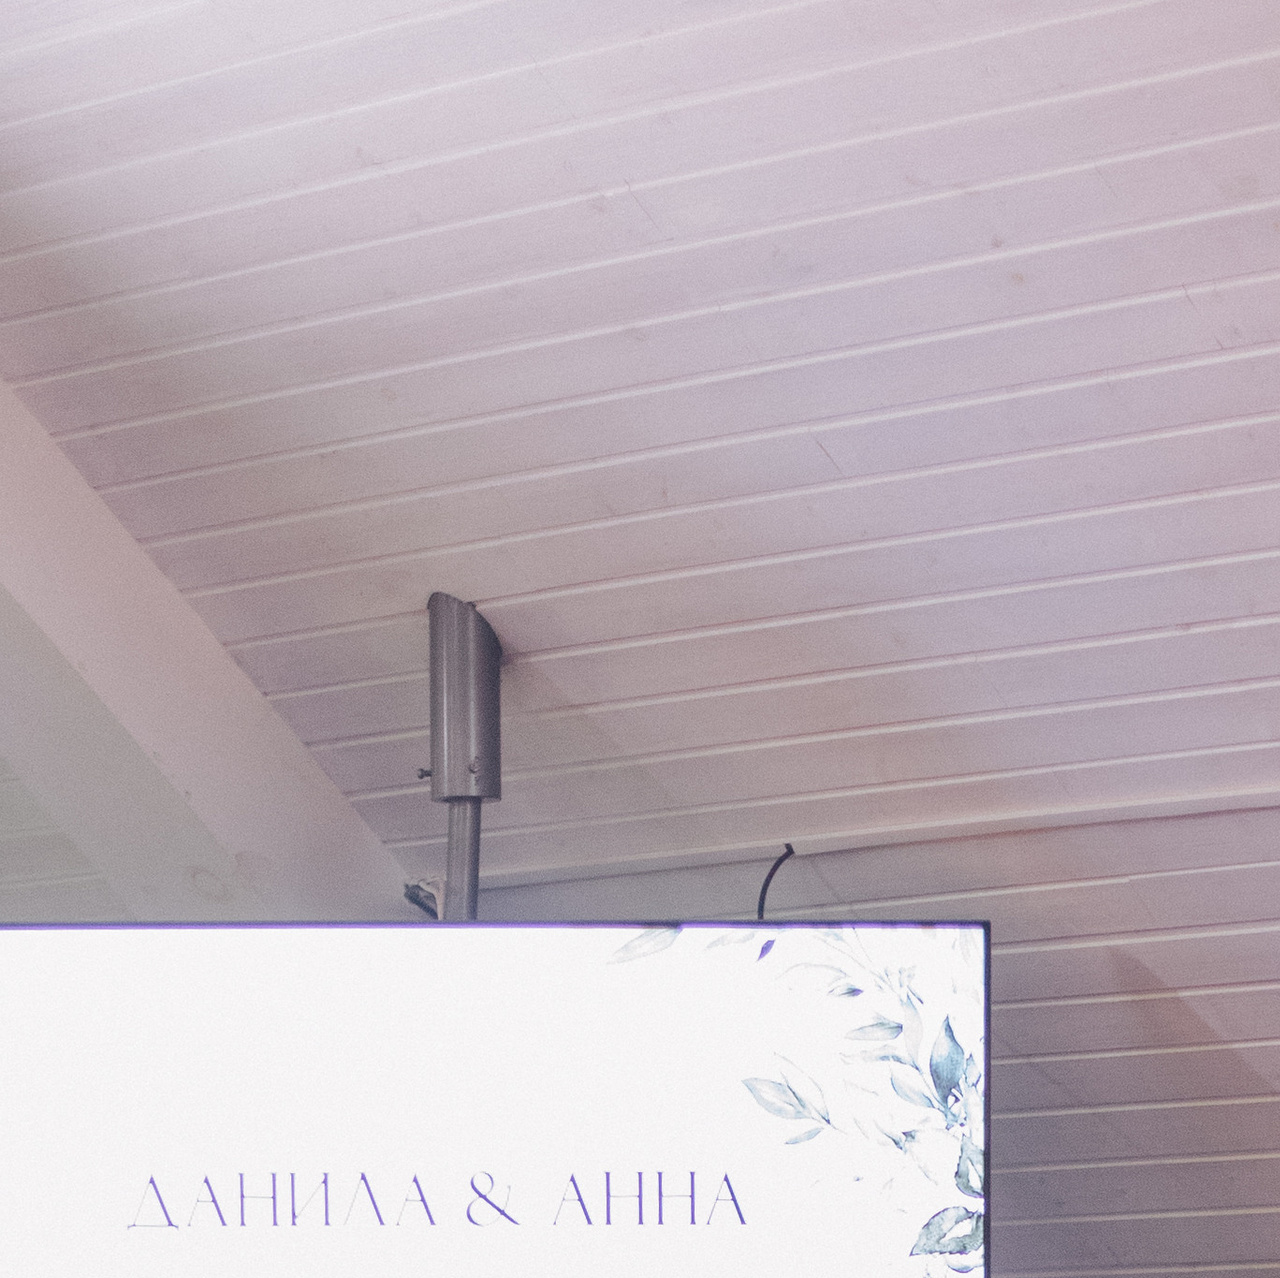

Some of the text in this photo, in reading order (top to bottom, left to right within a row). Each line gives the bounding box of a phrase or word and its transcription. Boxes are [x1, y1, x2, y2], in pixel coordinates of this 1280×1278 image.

[126, 1170, 748, 1229] ДАНИЛА & АННА
